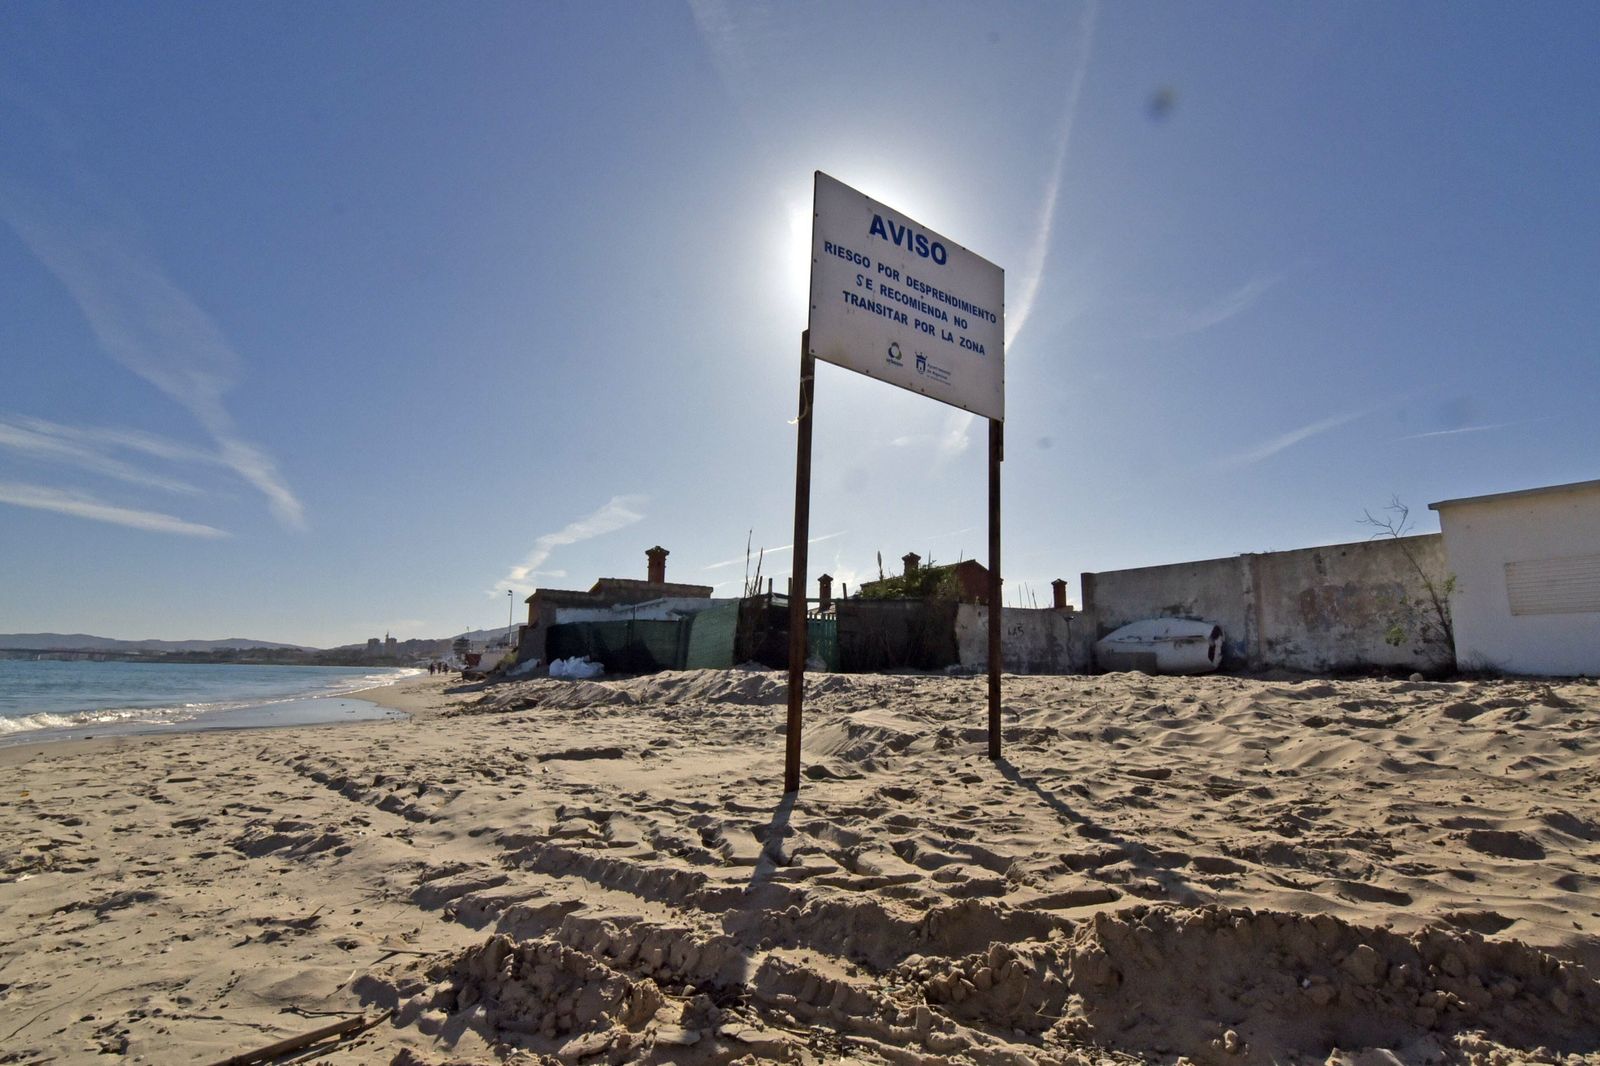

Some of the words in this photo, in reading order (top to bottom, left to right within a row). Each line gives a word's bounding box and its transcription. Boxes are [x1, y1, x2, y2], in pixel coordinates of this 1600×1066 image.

[869, 213, 947, 266] AVISO
[824, 241, 871, 269] RIESGO
[878, 262, 900, 282] POR
[906, 276, 997, 324] DESPRENDIMIENTO
[856, 274, 873, 291] SE
[880, 284, 948, 322] RECOMIENDA
[954, 316, 968, 329] NO
[842, 290, 908, 325] TRANSITAR
[914, 318, 935, 336] POR
[941, 329, 954, 343] LA
[960, 336, 985, 356] ZONA
